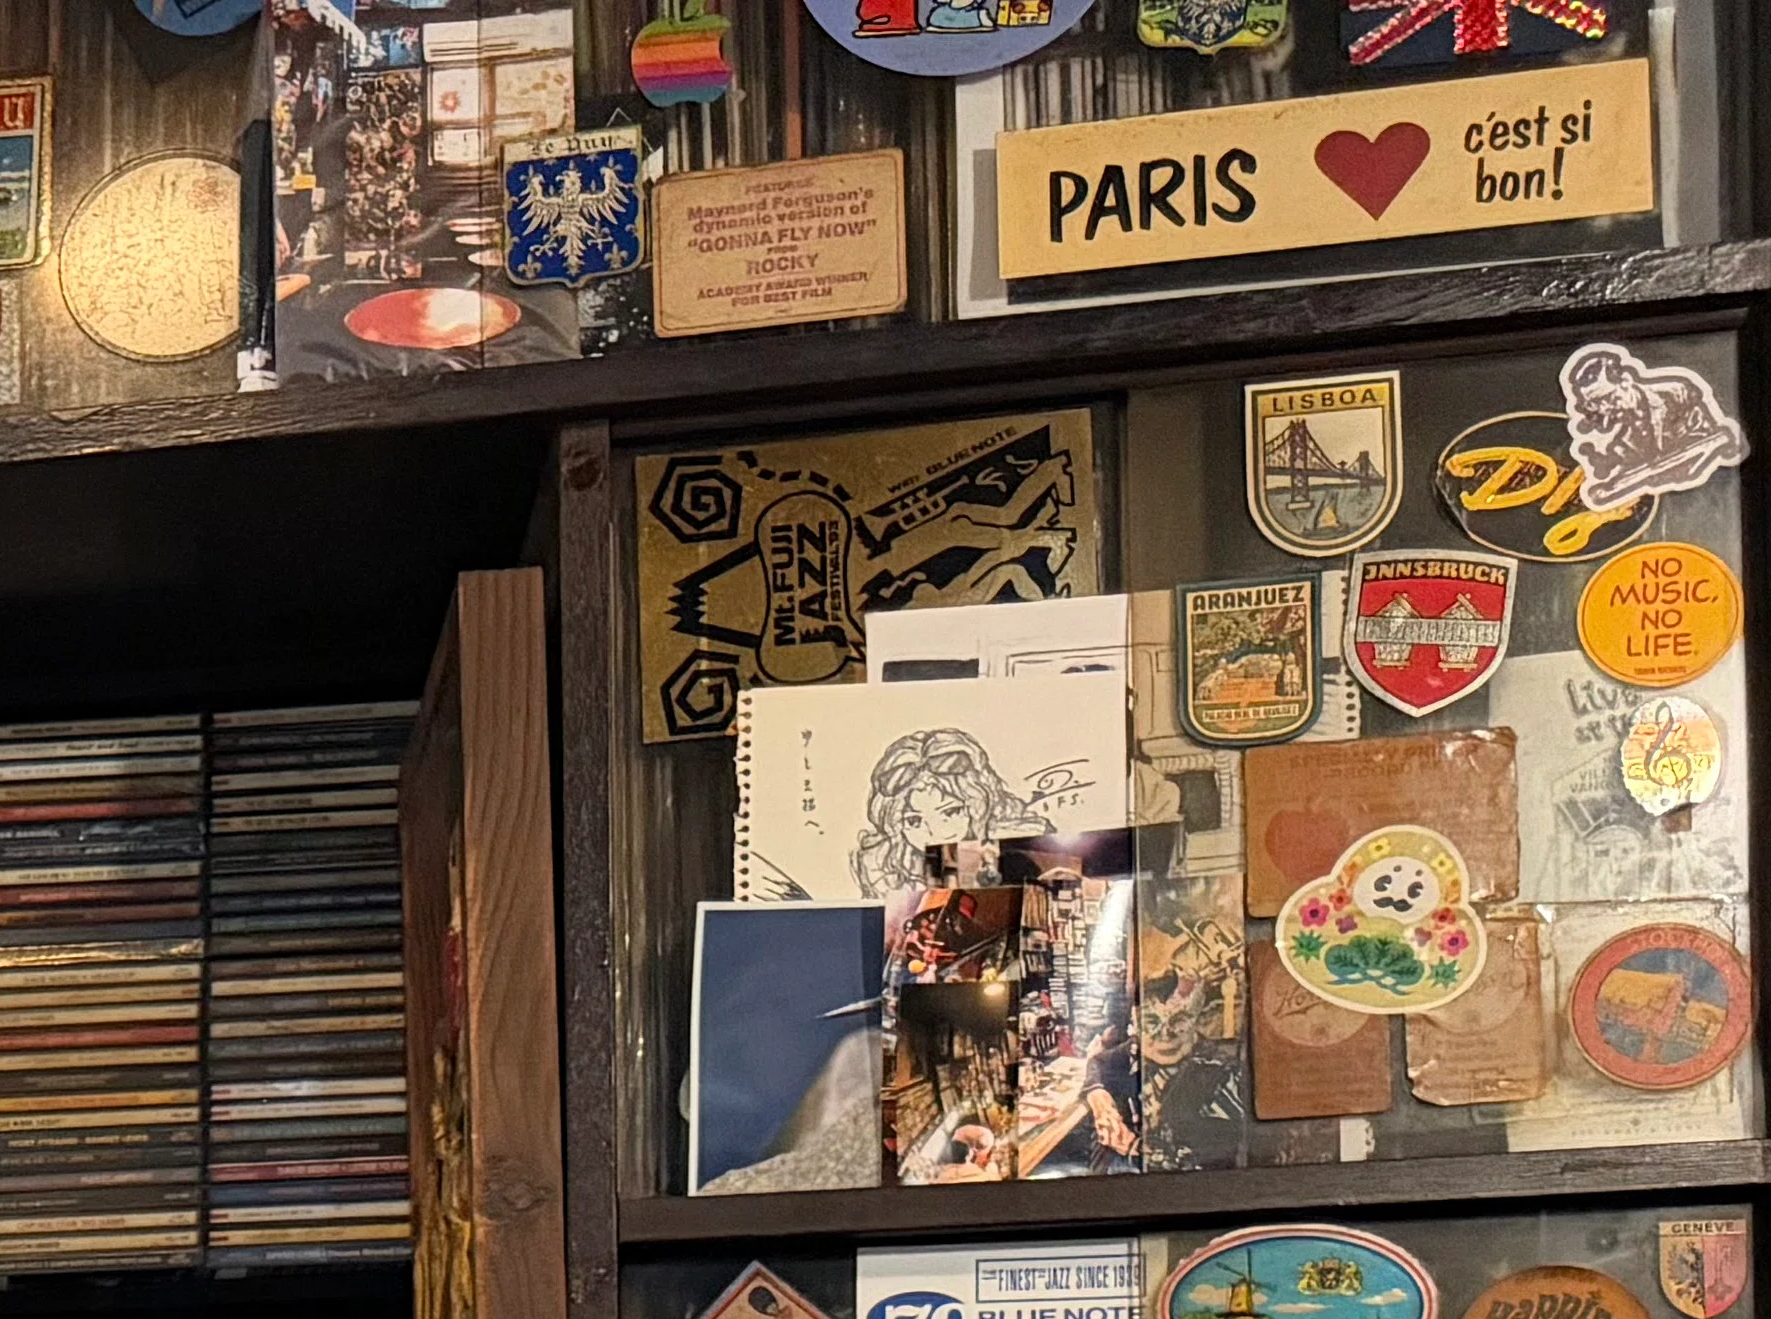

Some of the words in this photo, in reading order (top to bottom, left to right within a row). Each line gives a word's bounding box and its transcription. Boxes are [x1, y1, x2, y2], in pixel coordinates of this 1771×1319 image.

[1560, 99, 1592, 146] si
[1475, 148, 1565, 204] bon!
[687, 199, 768, 221] Maynard
[771, 187, 875, 211] Ferguson's
[1049, 147, 1257, 243] PARIS
[775, 205, 845, 225] version
[849, 200, 867, 215] of
[777, 226, 813, 244] FLY
[746, 253, 819, 275] ROCKY
[1272, 387, 1378, 413] LISBOA
[1640, 558, 1683, 580] NO
[797, 521, 847, 648] JAZZ
[1192, 584, 1305, 612] ARANJUEZ
[1609, 579, 1719, 607] MUSIC,
[1640, 609, 1683, 631] NO
[1626, 632, 1699, 657] LIFE.
[997, 1268, 1037, 1292] FINEST
[1044, 1266, 1071, 1290] JAZZ
[1076, 1264, 1109, 1289] SINCE
[1114, 1262, 1141, 1288] 1939
